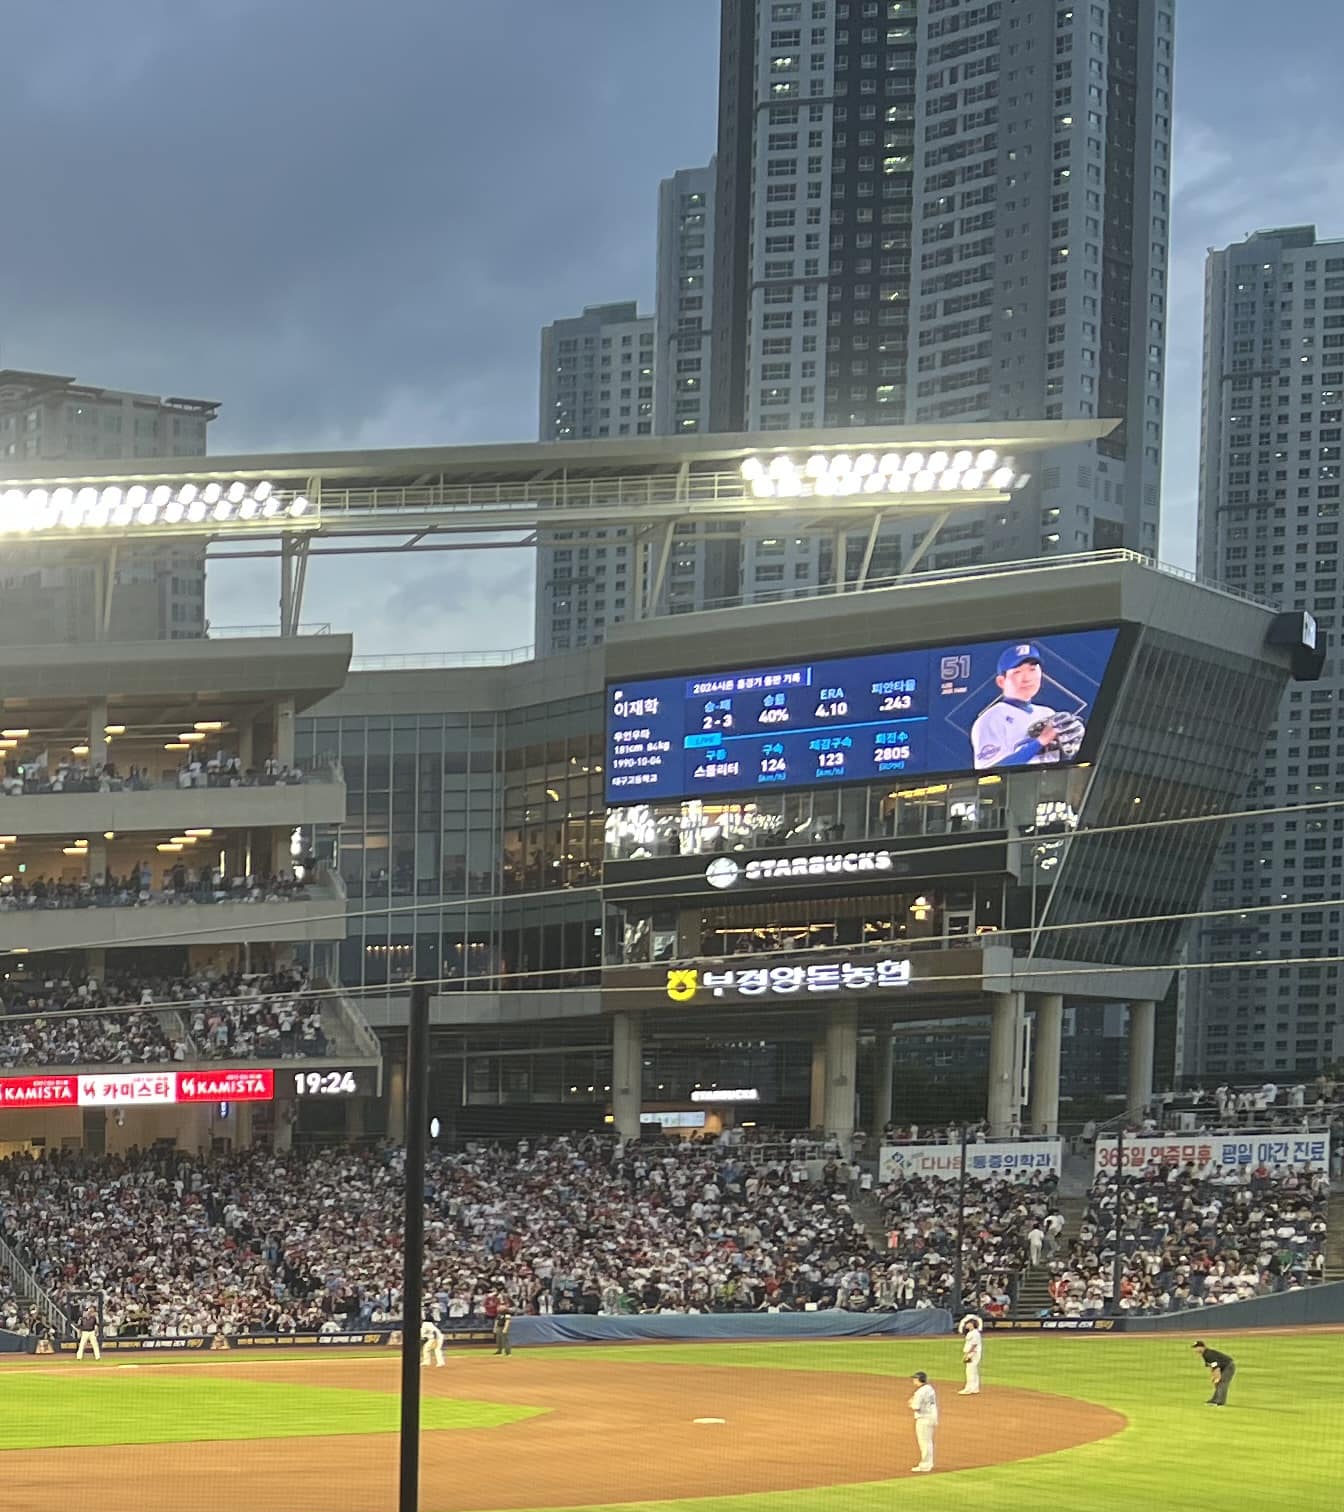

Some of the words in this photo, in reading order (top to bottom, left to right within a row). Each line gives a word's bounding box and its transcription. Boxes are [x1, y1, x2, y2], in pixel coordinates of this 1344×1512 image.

[940, 654, 971, 681] 51
[820, 688, 844, 701] ERA
[613, 697, 659, 718] 이재학
[758, 708, 790, 724] 40%
[815, 702, 848, 718] 4.10
[760, 757, 786, 773] 124
[818, 752, 844, 767] 123
[873, 746, 910, 762] 2805
[744, 850, 893, 880] STARBUCKS
[702, 960, 912, 997] 부경양돈농협
[4, 1082, 72, 1100] KAMISTA
[103, 1080, 170, 1100] 카미스타
[194, 1078, 266, 1095] KAMISTA
[294, 1070, 357, 1095] 19:24
[1098, 1147, 1146, 1168] 365일
[1221, 1143, 1253, 1165] 평일
[1257, 1142, 1289, 1163] 야간
[1293, 1141, 1325, 1162] 진료
